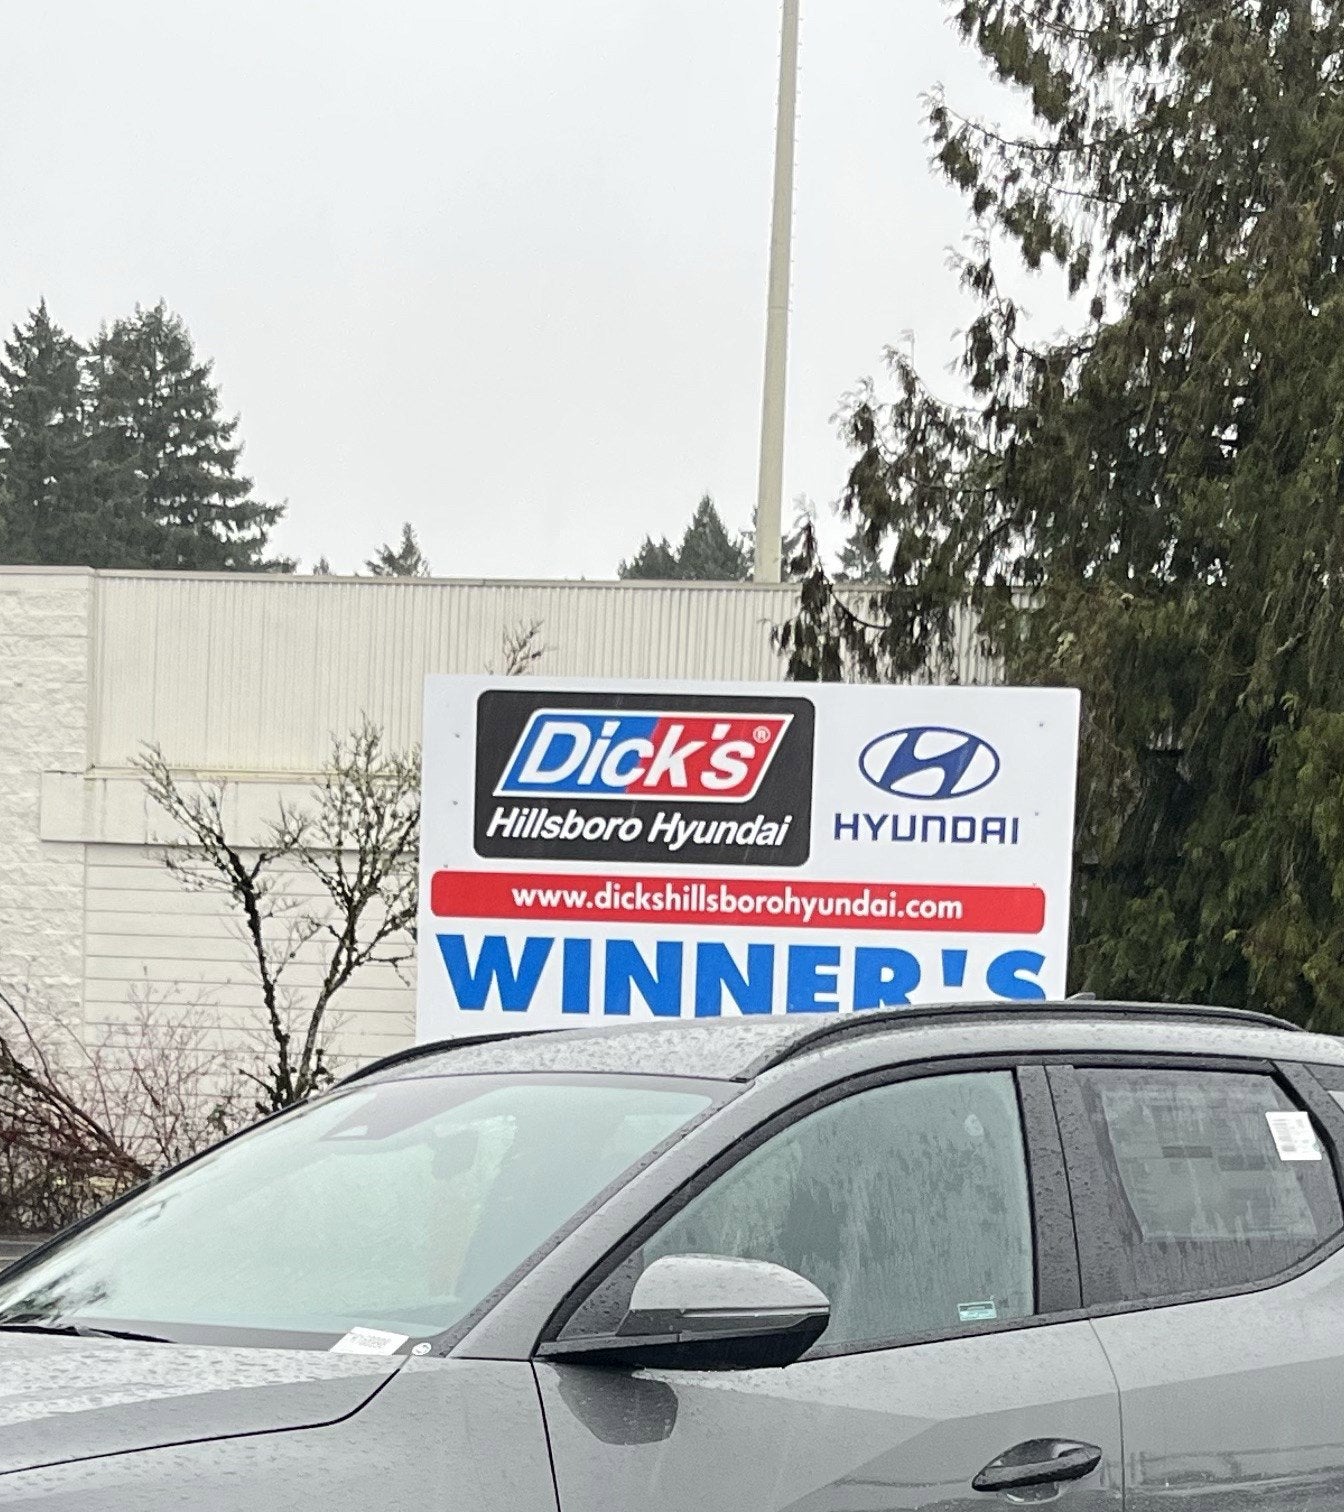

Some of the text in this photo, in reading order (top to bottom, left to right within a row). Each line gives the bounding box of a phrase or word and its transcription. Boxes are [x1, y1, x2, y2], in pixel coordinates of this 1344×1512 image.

[517, 720, 756, 790] Dick's
[486, 807, 793, 850] Hillsboro Hyundai
[834, 813, 1019, 844] HYUNDAI
[511, 881, 963, 922] www.dickshillsborohyundai.com
[436, 933, 1046, 1016] WINNER'S
